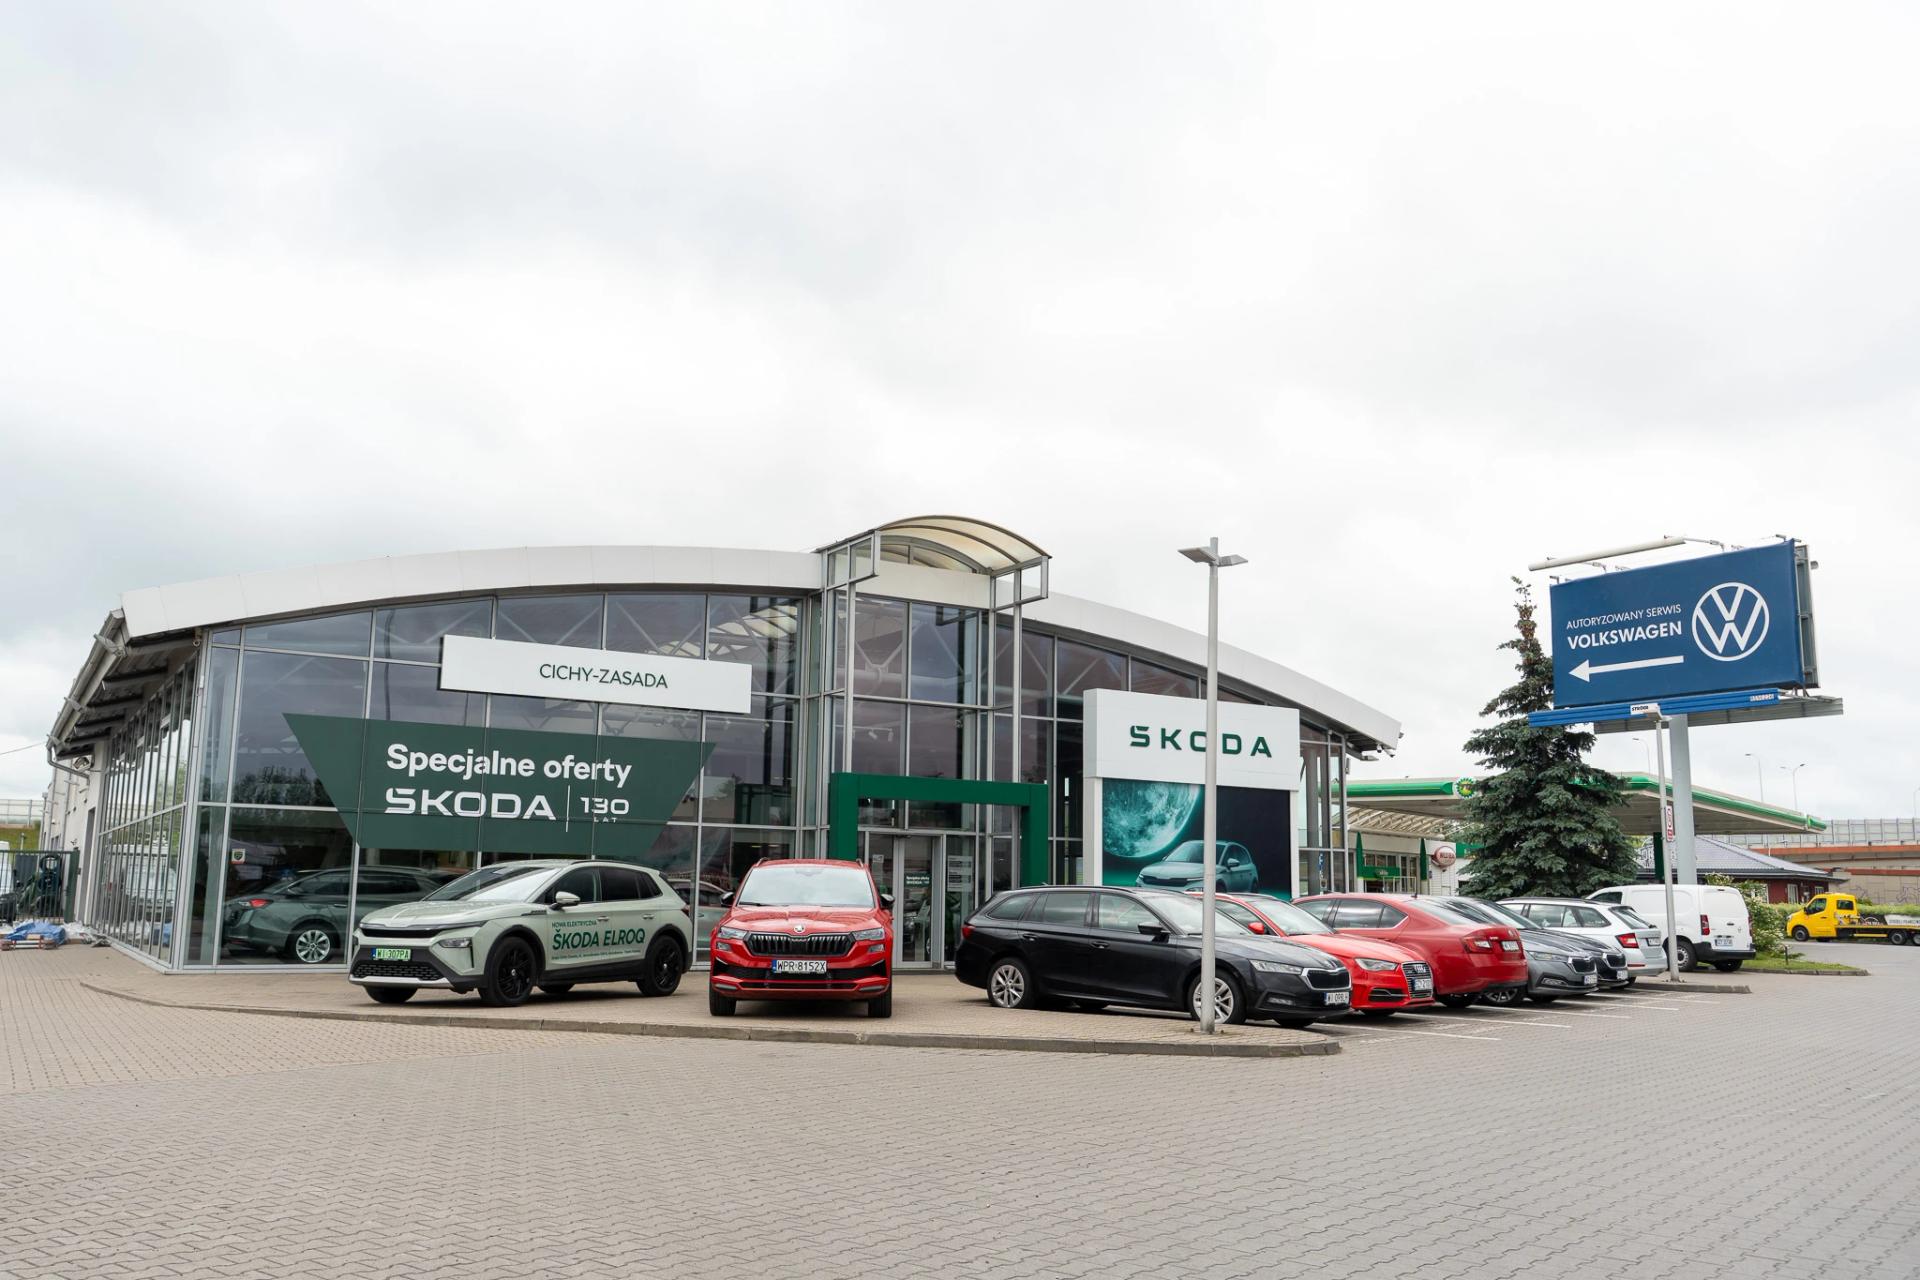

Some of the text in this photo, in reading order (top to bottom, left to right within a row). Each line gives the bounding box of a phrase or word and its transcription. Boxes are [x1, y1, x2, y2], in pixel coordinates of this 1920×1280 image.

[1566, 604, 1682, 629] AUTORYZOWANY SERWIS
[1567, 620, 1683, 650] VOLKSWAGEN
[539, 663, 668, 689] CICHY-ZASADA
[386, 743, 633, 788] Specjalne oferty
[580, 796, 630, 815] 130
[552, 927, 646, 950] ŠKODA ELROQ
[777, 961, 825, 972] WPR 8152X
